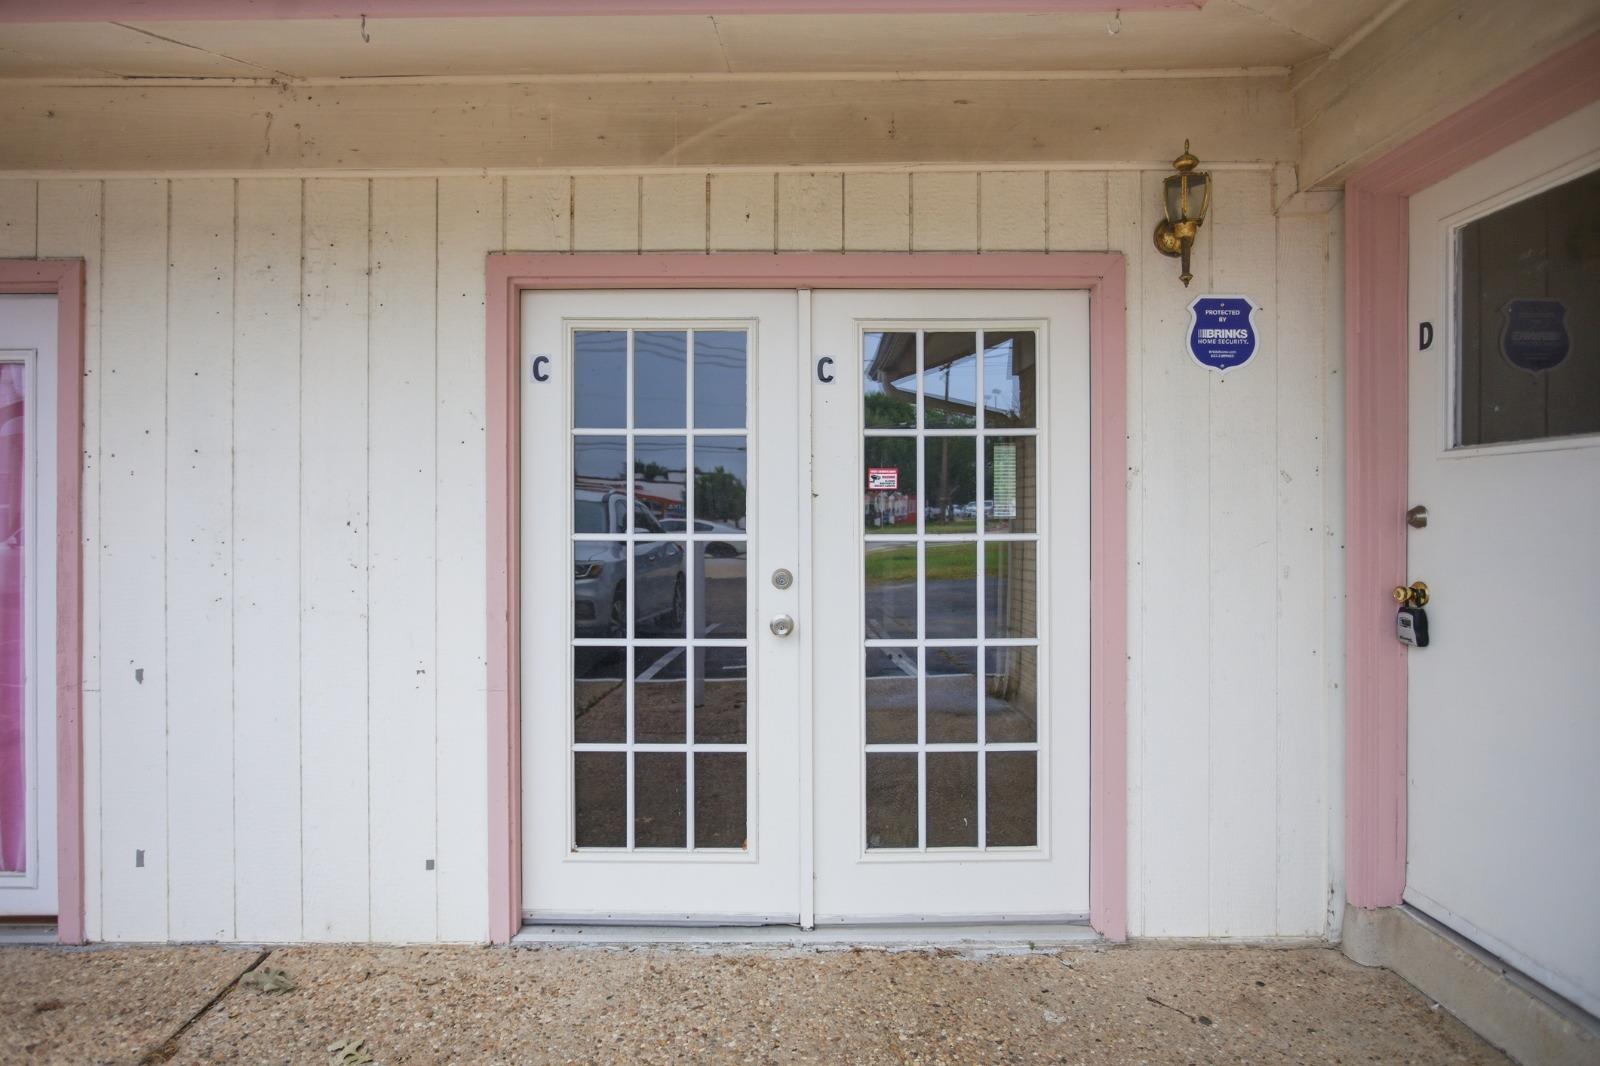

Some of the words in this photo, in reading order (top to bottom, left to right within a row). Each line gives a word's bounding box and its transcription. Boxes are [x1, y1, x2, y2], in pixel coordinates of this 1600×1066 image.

[1206, 328, 1248, 338] BRINKS
[1419, 322, 1434, 350] D
[532, 355, 550, 382] C
[817, 356, 834, 383] C
